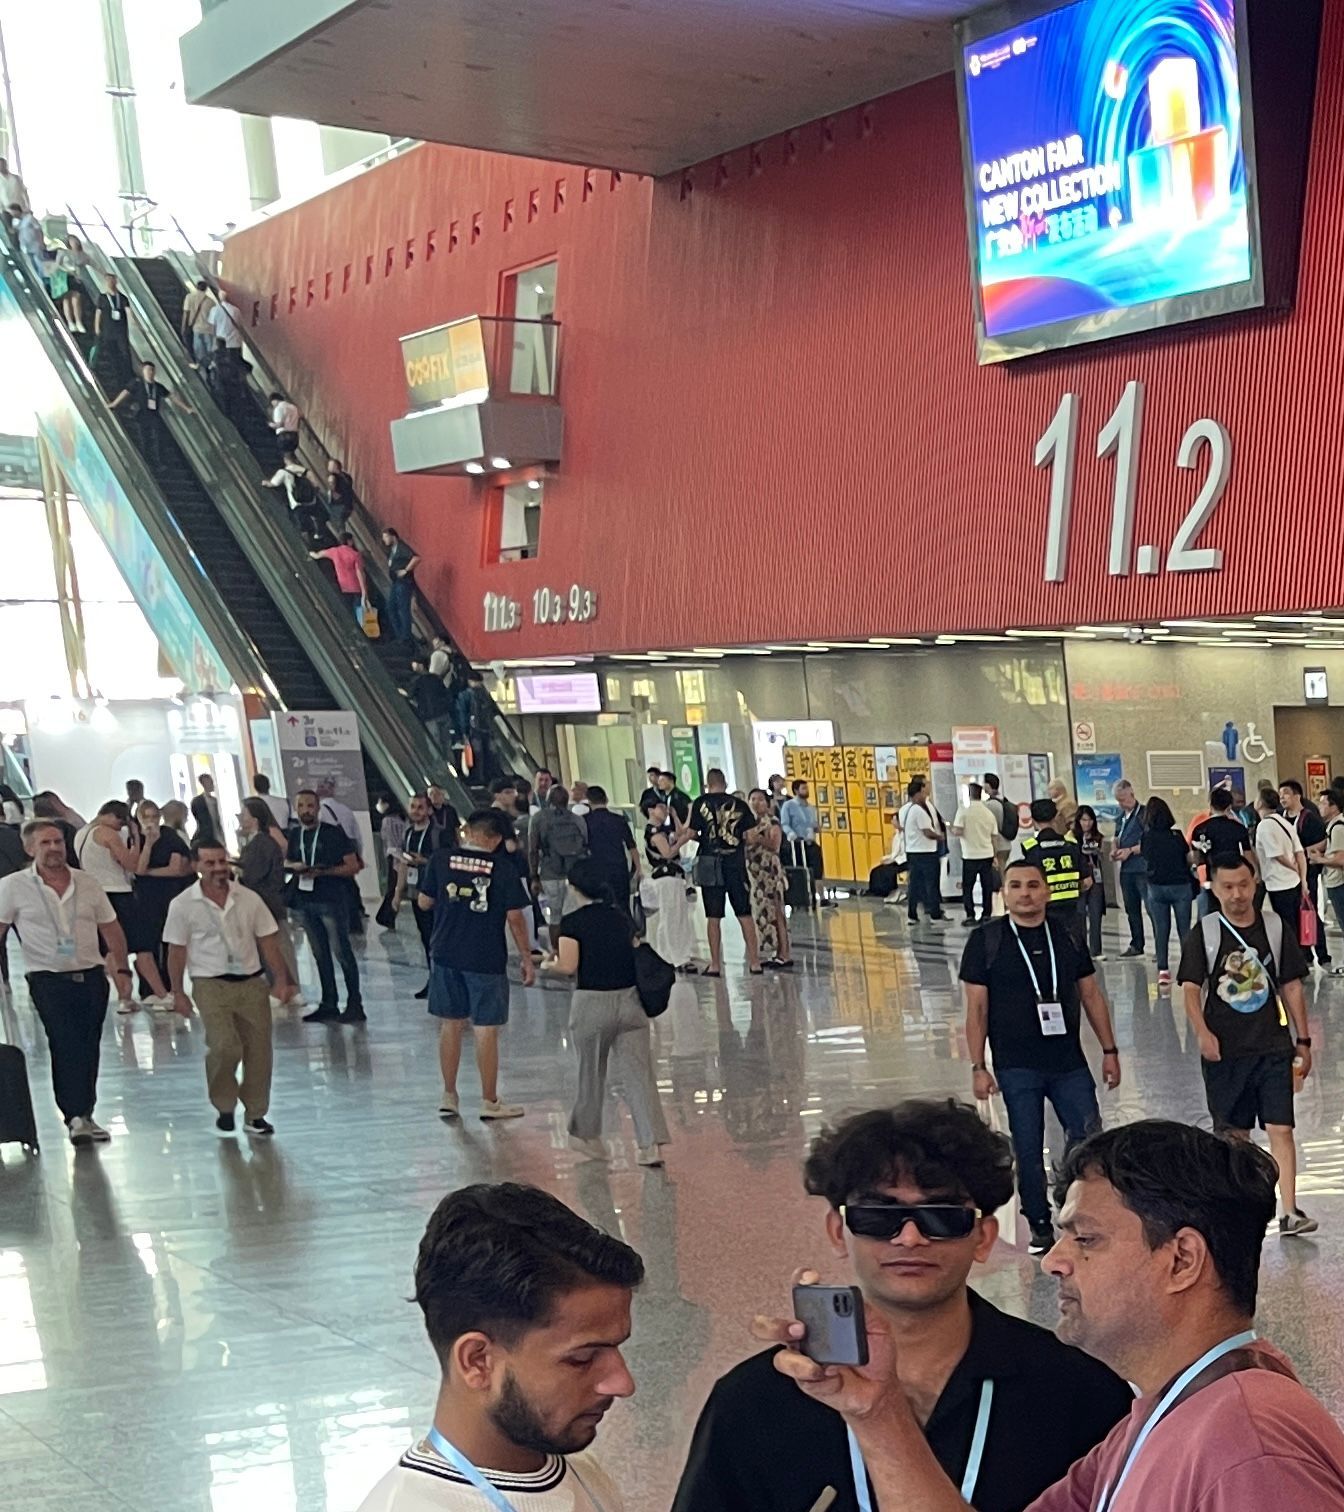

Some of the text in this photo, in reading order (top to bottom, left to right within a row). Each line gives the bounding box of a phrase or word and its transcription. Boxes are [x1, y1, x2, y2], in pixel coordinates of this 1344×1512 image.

[979, 134, 1084, 192] CANTON FAIR
[982, 161, 1122, 228] NEW COLLECTION
[1034, 379, 1234, 584] 11.2
[785, 749, 875, 781] 自助行李寄存
